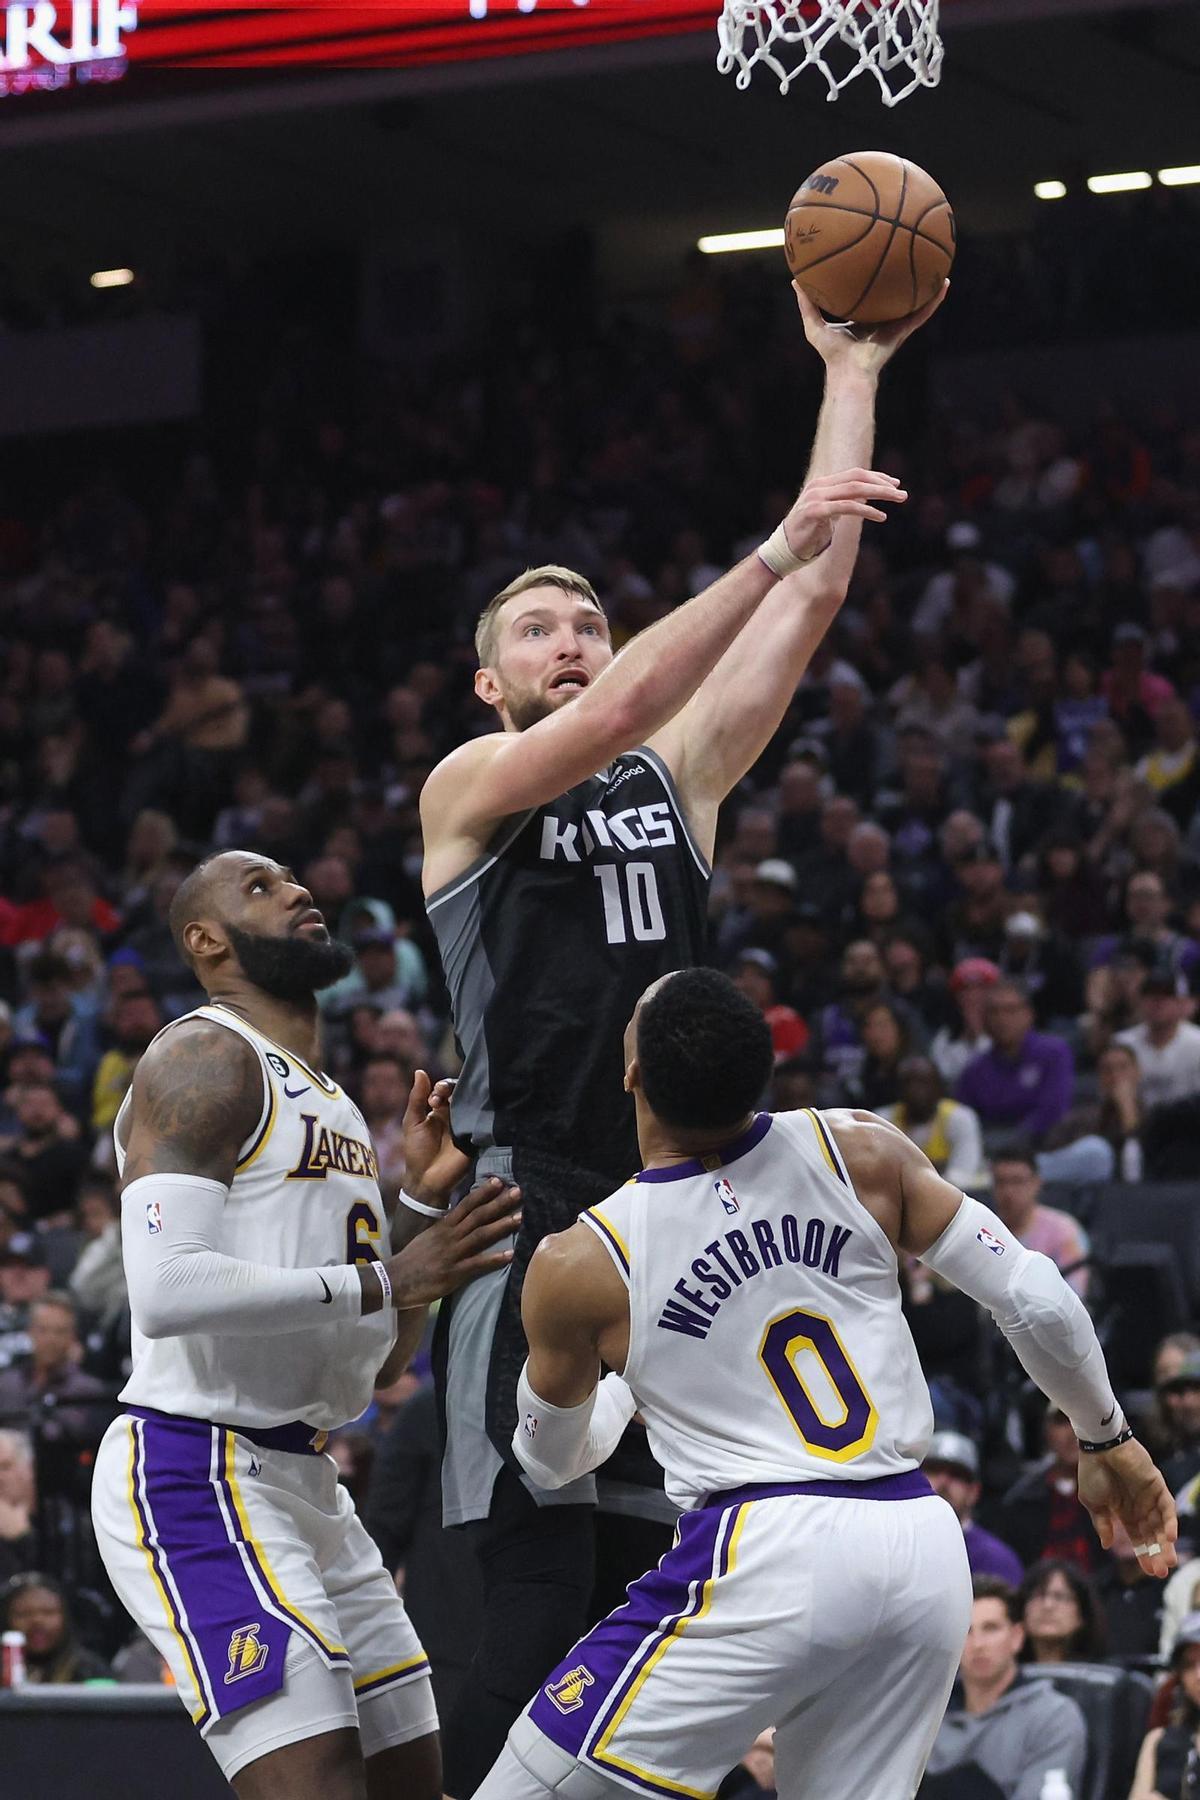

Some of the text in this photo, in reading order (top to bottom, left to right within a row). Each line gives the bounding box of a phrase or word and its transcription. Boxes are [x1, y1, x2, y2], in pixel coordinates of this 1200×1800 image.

[593, 862, 667, 944] 10
[346, 1200, 382, 1265] 6
[657, 1214, 853, 1340] WESTBROOK
[757, 1306, 880, 1464] 0
